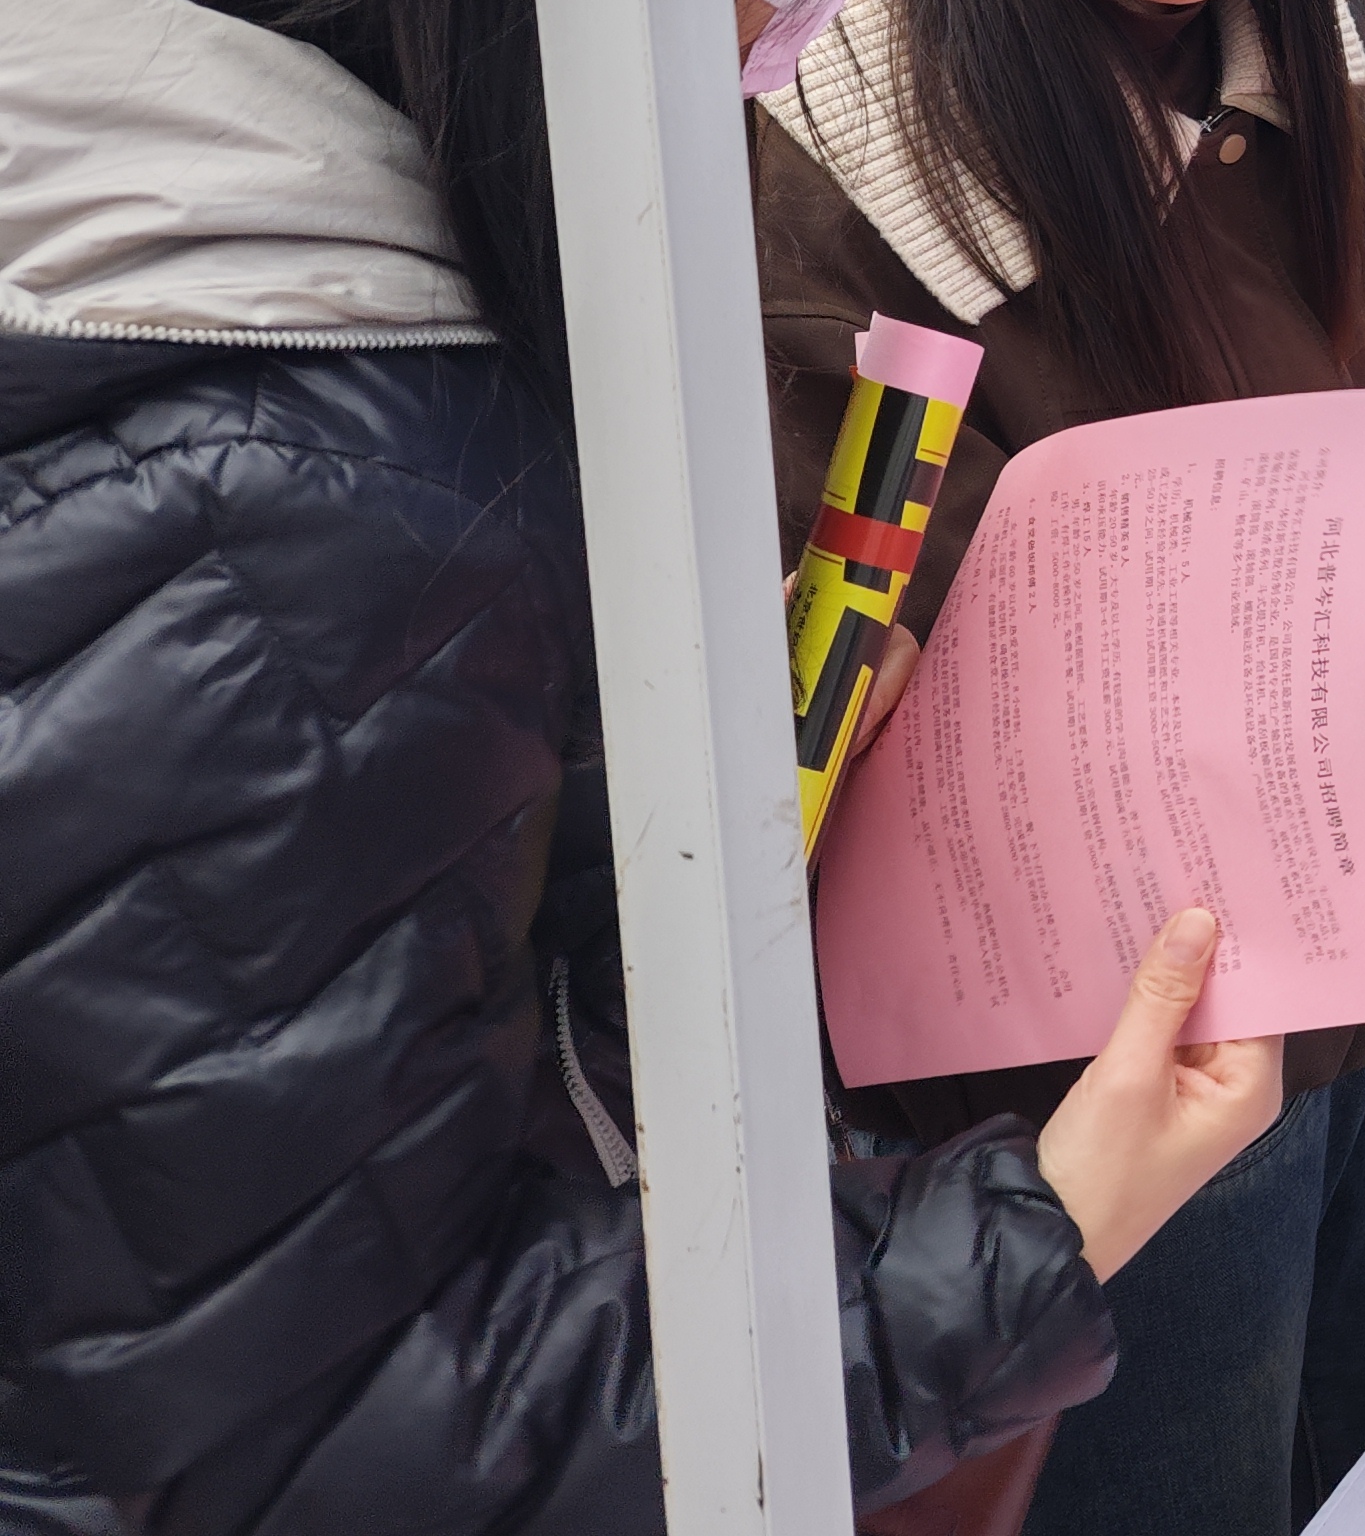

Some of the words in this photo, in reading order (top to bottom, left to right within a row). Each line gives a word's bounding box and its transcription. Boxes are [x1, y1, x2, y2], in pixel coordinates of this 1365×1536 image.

[1311, 517, 1355, 876] 河北普岑汇科技有限公司招聘简章
